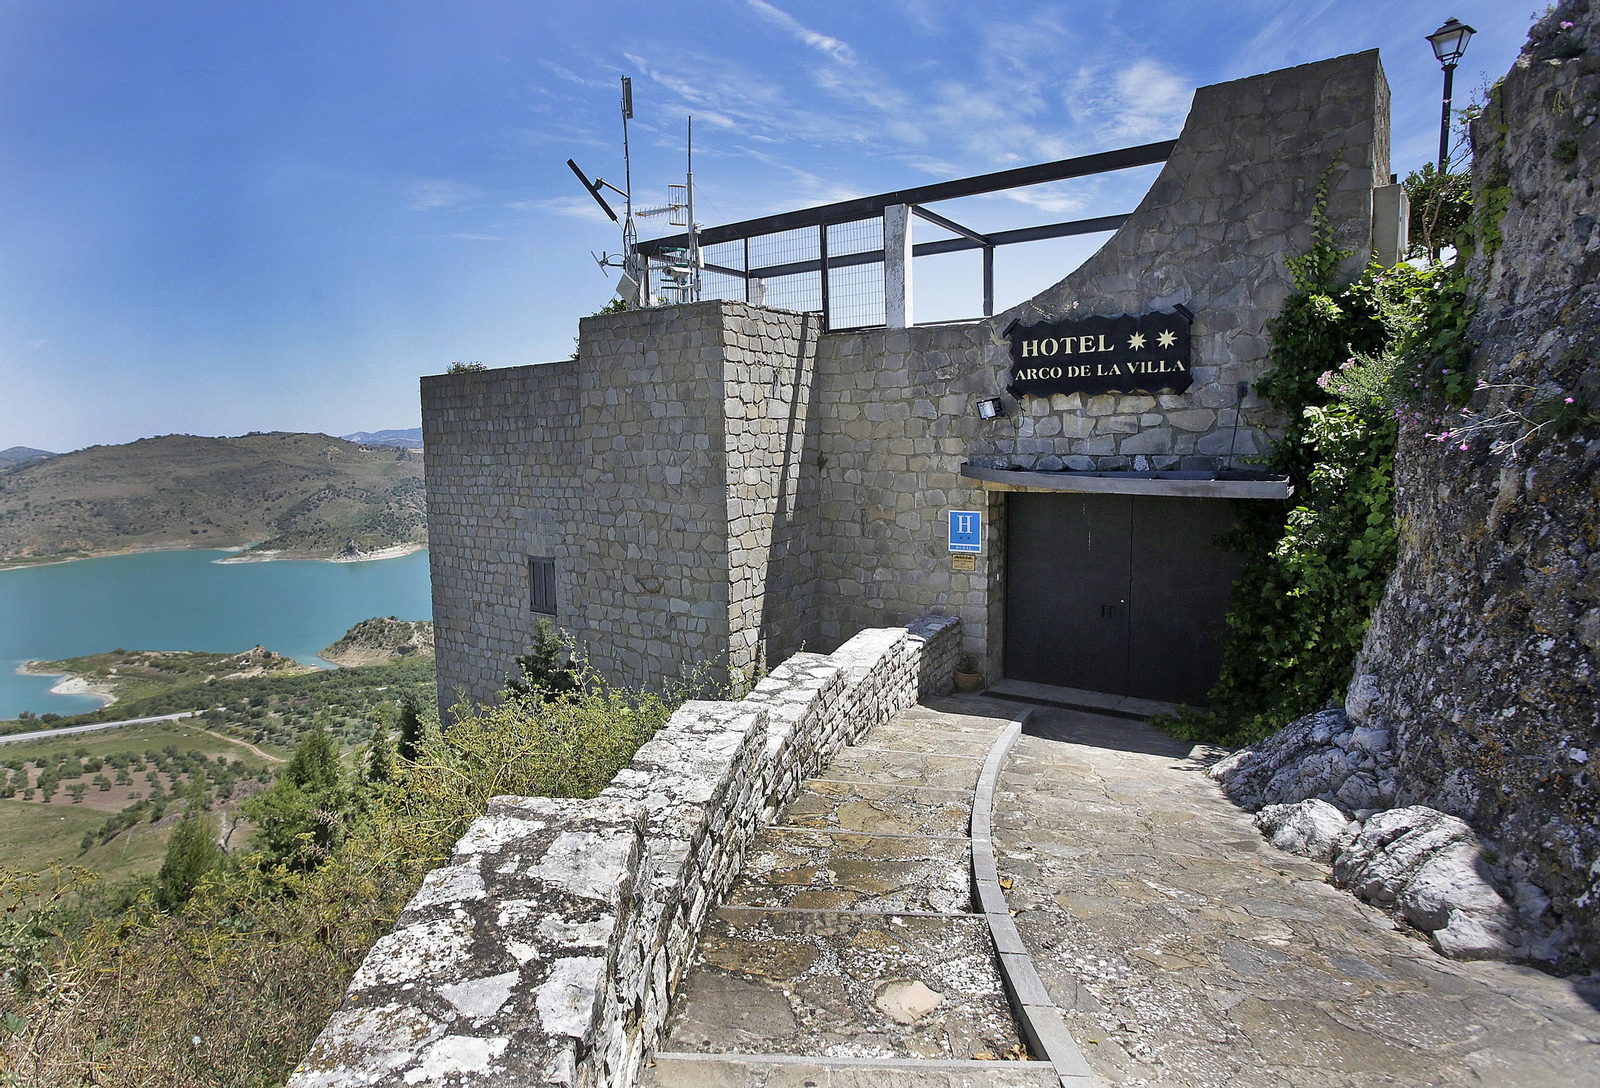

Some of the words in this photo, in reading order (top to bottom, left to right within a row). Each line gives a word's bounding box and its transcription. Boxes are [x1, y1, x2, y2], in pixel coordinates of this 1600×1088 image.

[1021, 334, 1115, 358] HOTEL
[1015, 366, 1063, 381] ARCO
[1067, 364, 1091, 378] DE
[1097, 363, 1122, 376] LA
[1126, 359, 1186, 374] VILLA
[956, 514, 973, 534] H
